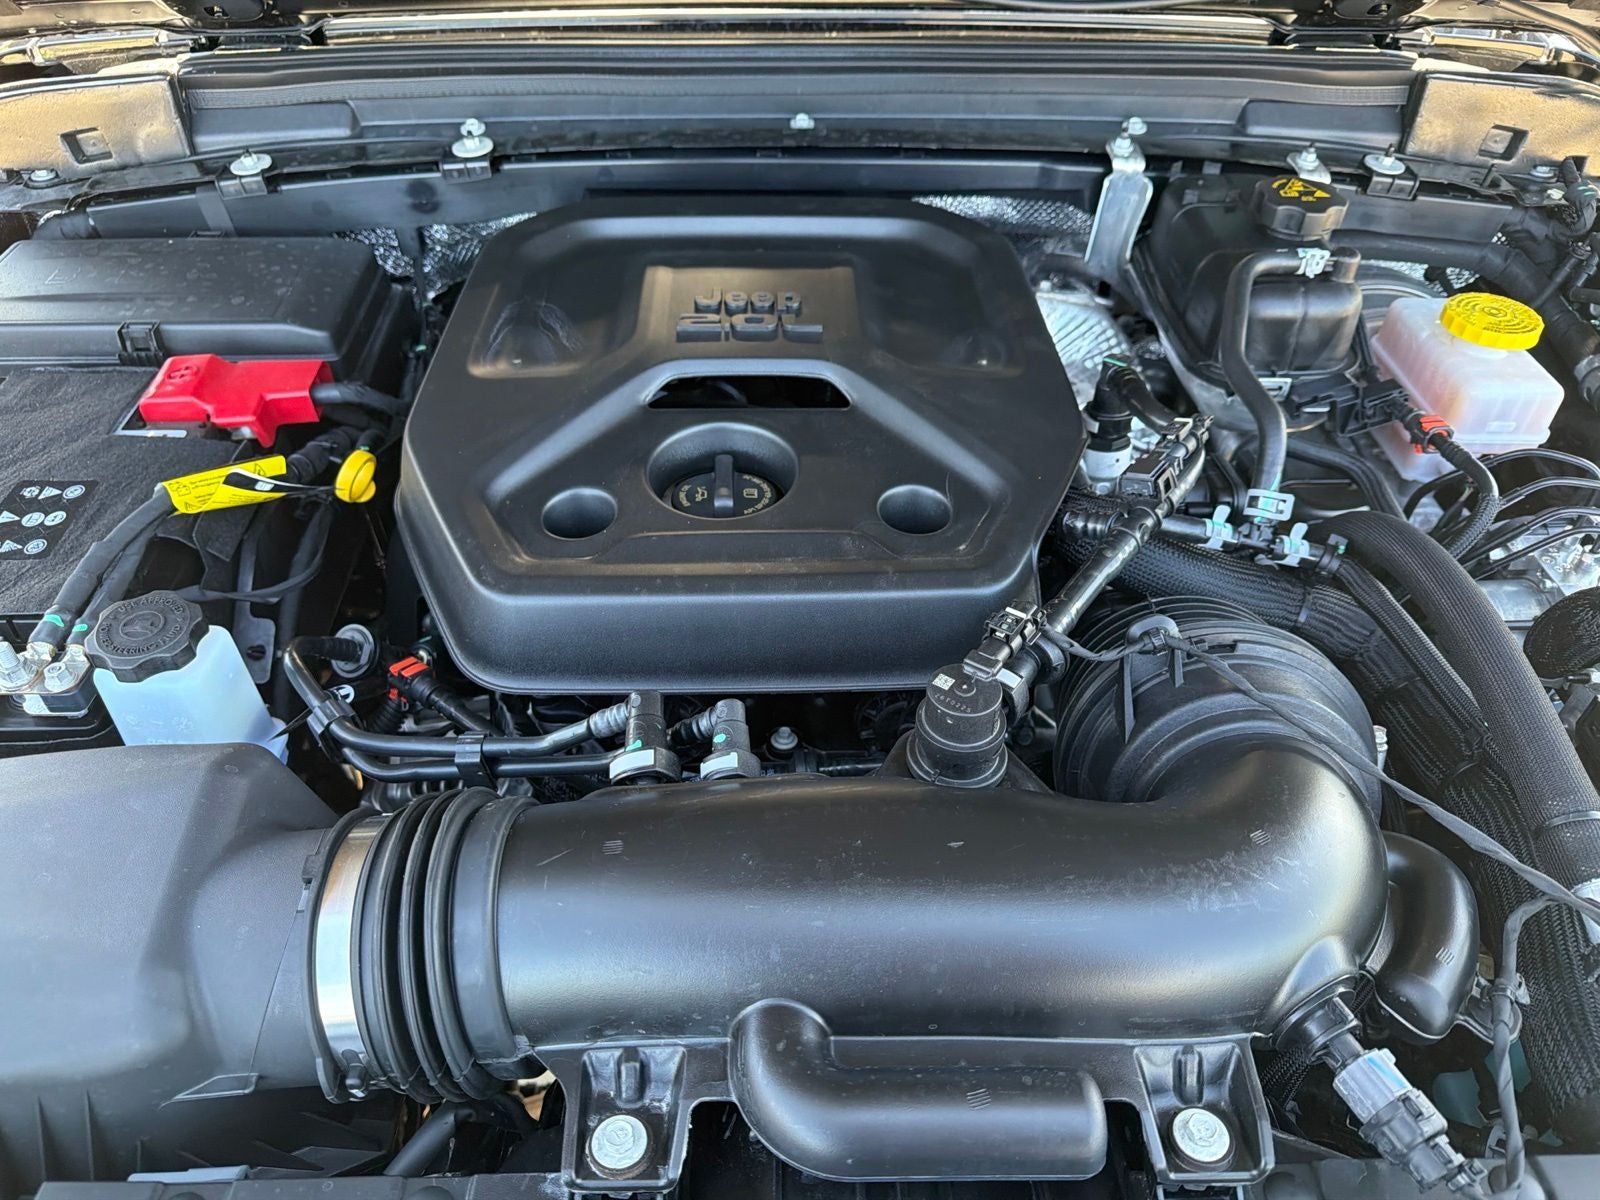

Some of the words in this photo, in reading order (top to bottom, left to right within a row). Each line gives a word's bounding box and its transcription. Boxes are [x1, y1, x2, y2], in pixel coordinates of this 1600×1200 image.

[694, 287, 801, 316] Jeep
[676, 313, 824, 343] 2.0L
[118, 600, 138, 613] USE
[140, 596, 184, 614] APPROVED
[111, 642, 156, 655] STEERING
[158, 624, 181, 646] FLUID
